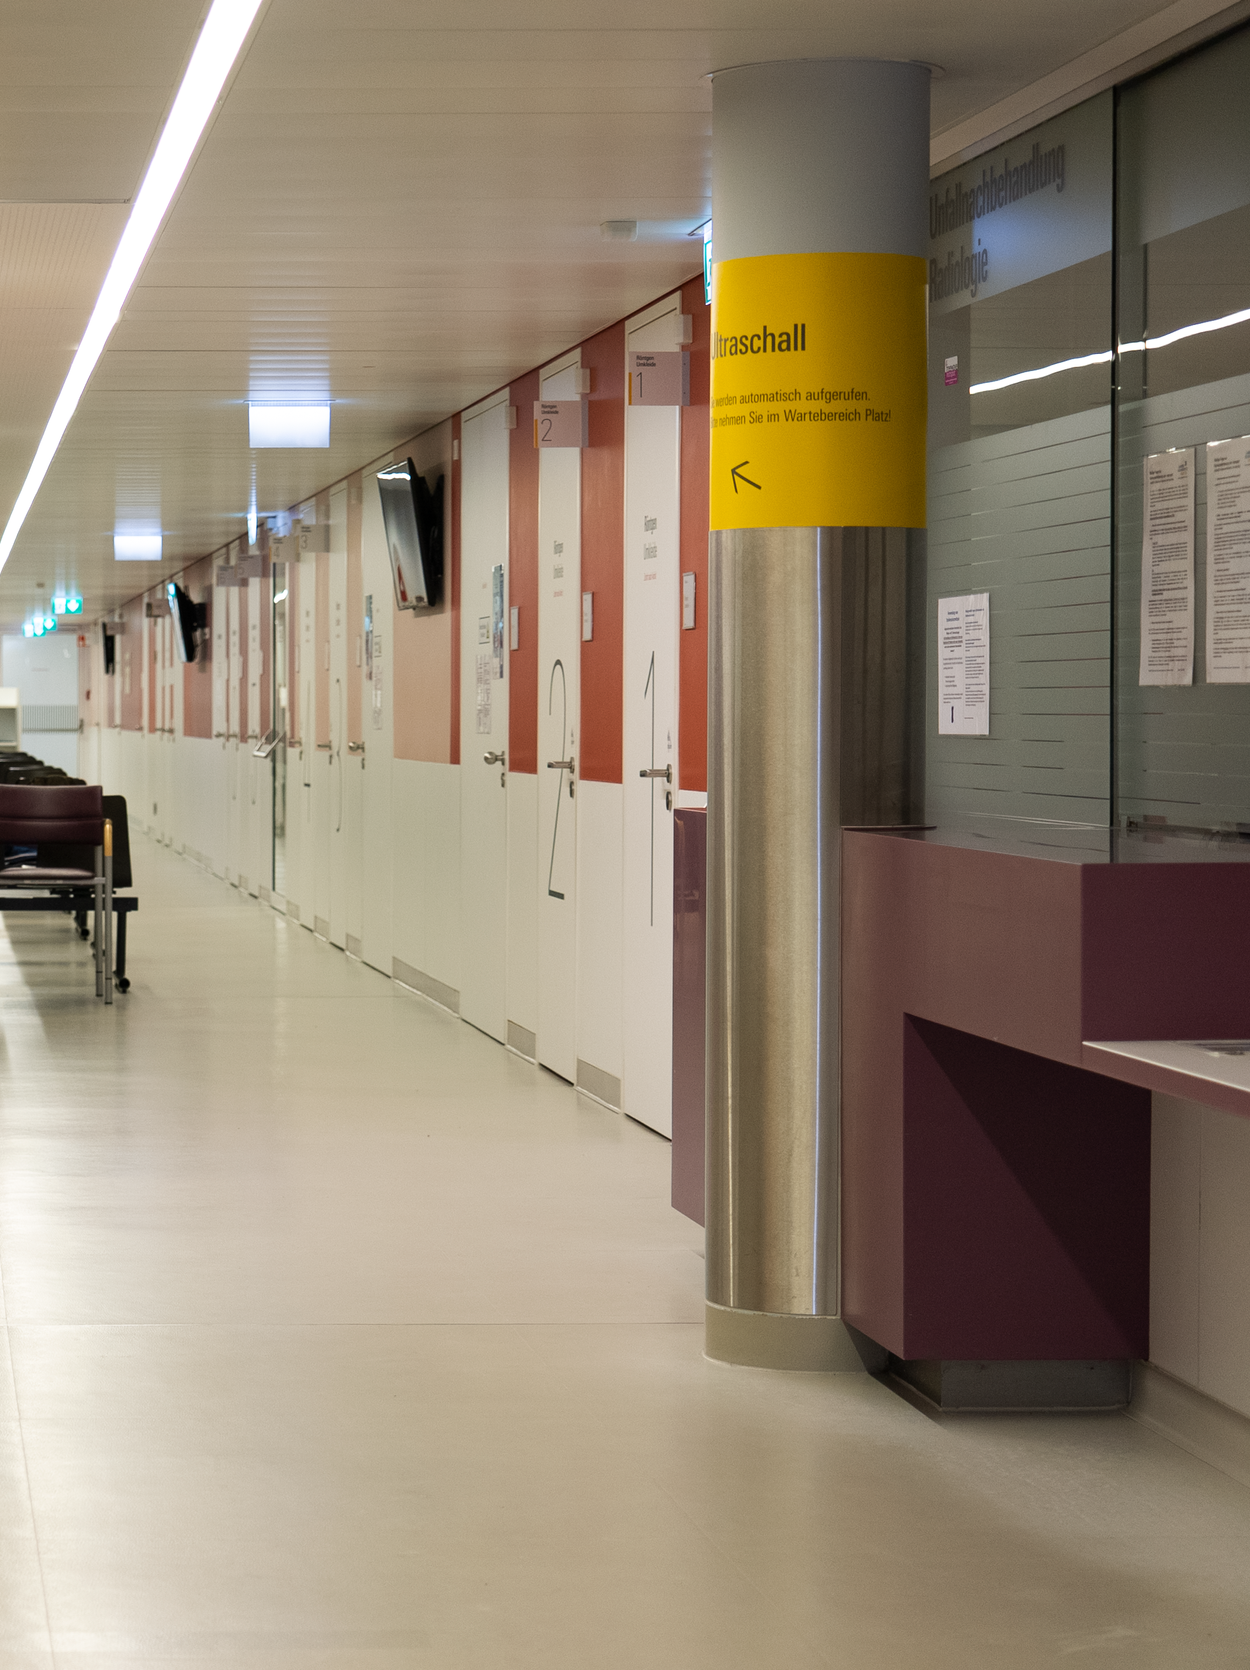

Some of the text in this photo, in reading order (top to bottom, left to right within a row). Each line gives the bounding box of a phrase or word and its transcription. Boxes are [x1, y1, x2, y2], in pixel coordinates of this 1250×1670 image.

[929, 237, 988, 302] Radiologie
[636, 372, 643, 398] 1
[739, 388, 802, 405] automatisch
[805, 388, 871, 404] aufgerufen.
[541, 418, 552, 442] 2
[719, 413, 746, 428] nehmen
[748, 411, 764, 424] Sie
[767, 410, 780, 423] im
[784, 408, 862, 423] Wartebereich
[865, 408, 892, 422] Platz!
[644, 650, 655, 926] 1
